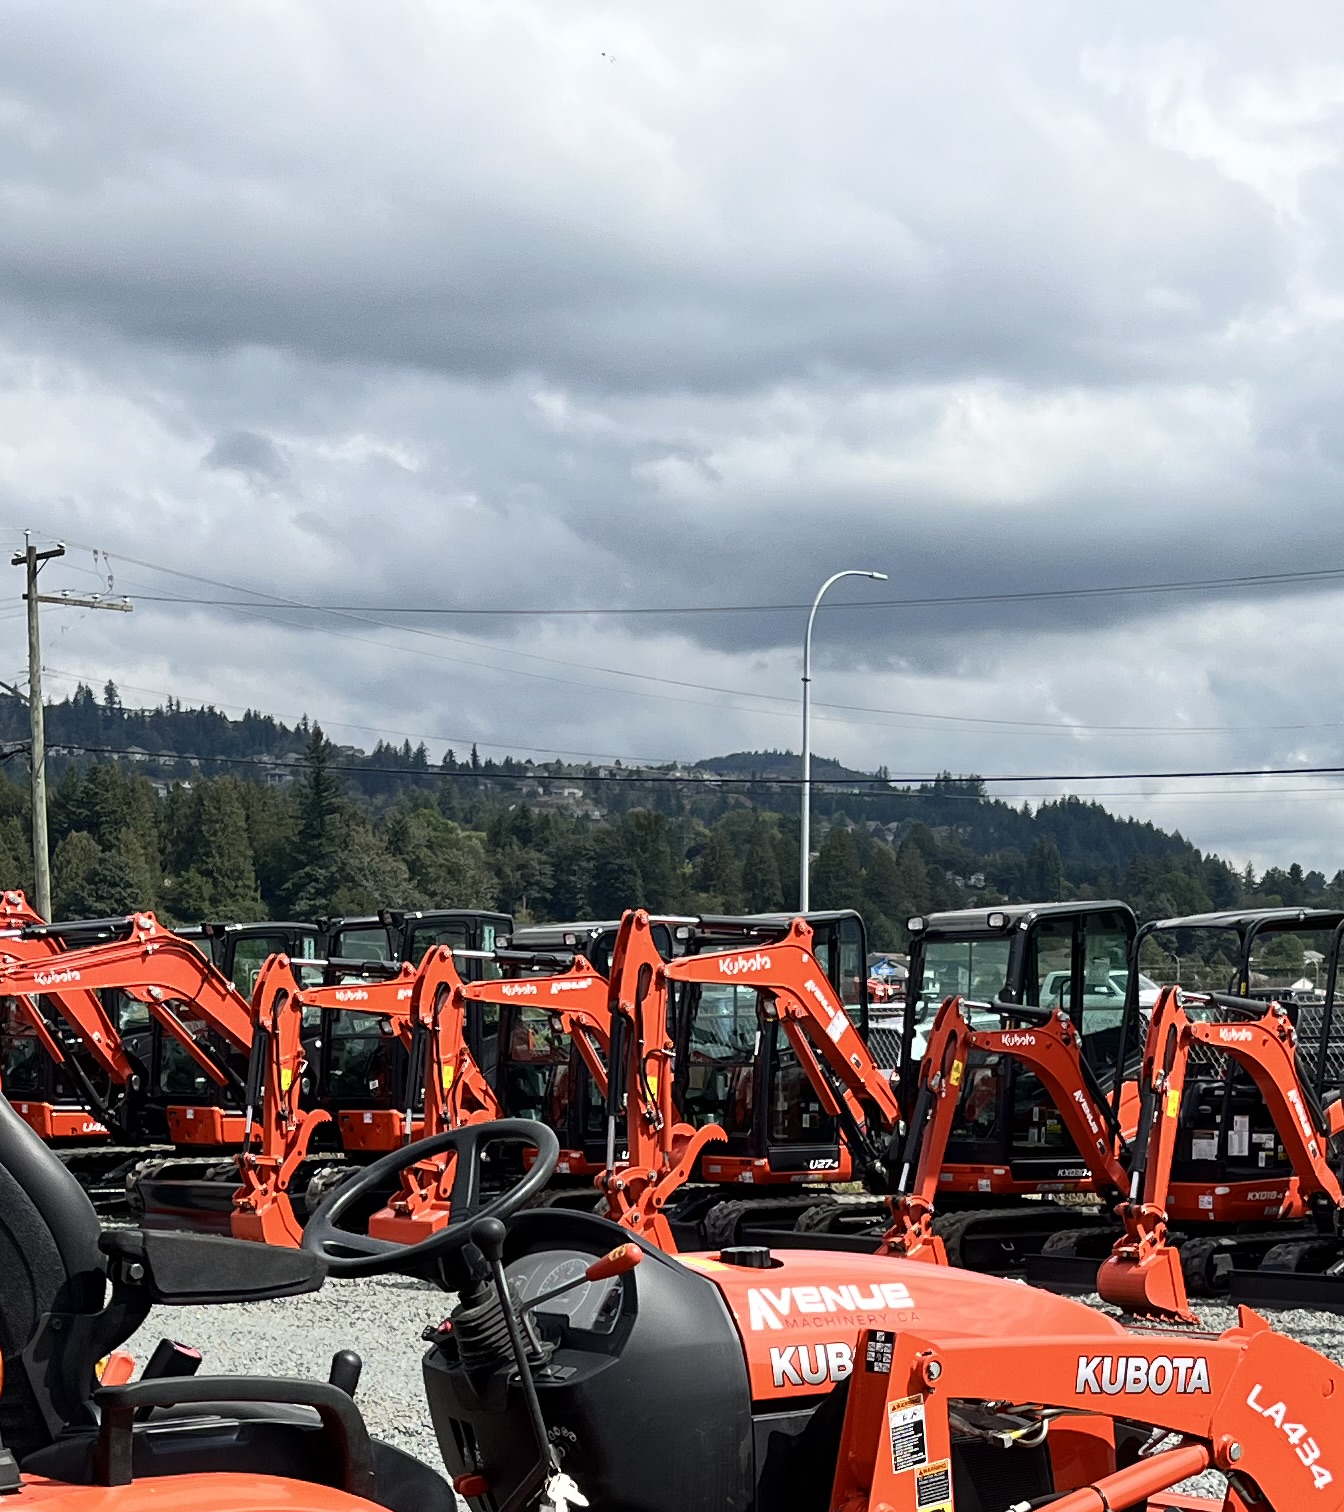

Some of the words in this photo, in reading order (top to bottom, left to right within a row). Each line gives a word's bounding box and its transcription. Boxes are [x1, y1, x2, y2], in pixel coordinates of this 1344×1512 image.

[718, 953, 772, 975] Kubota
[1001, 1033, 1036, 1046] Kubota
[1219, 1027, 1253, 1041] Kubota
[747, 1283, 915, 1331] AVENUE
[1075, 1355, 1212, 1394] KUBOTA
[1246, 1383, 1334, 1490] LA434
